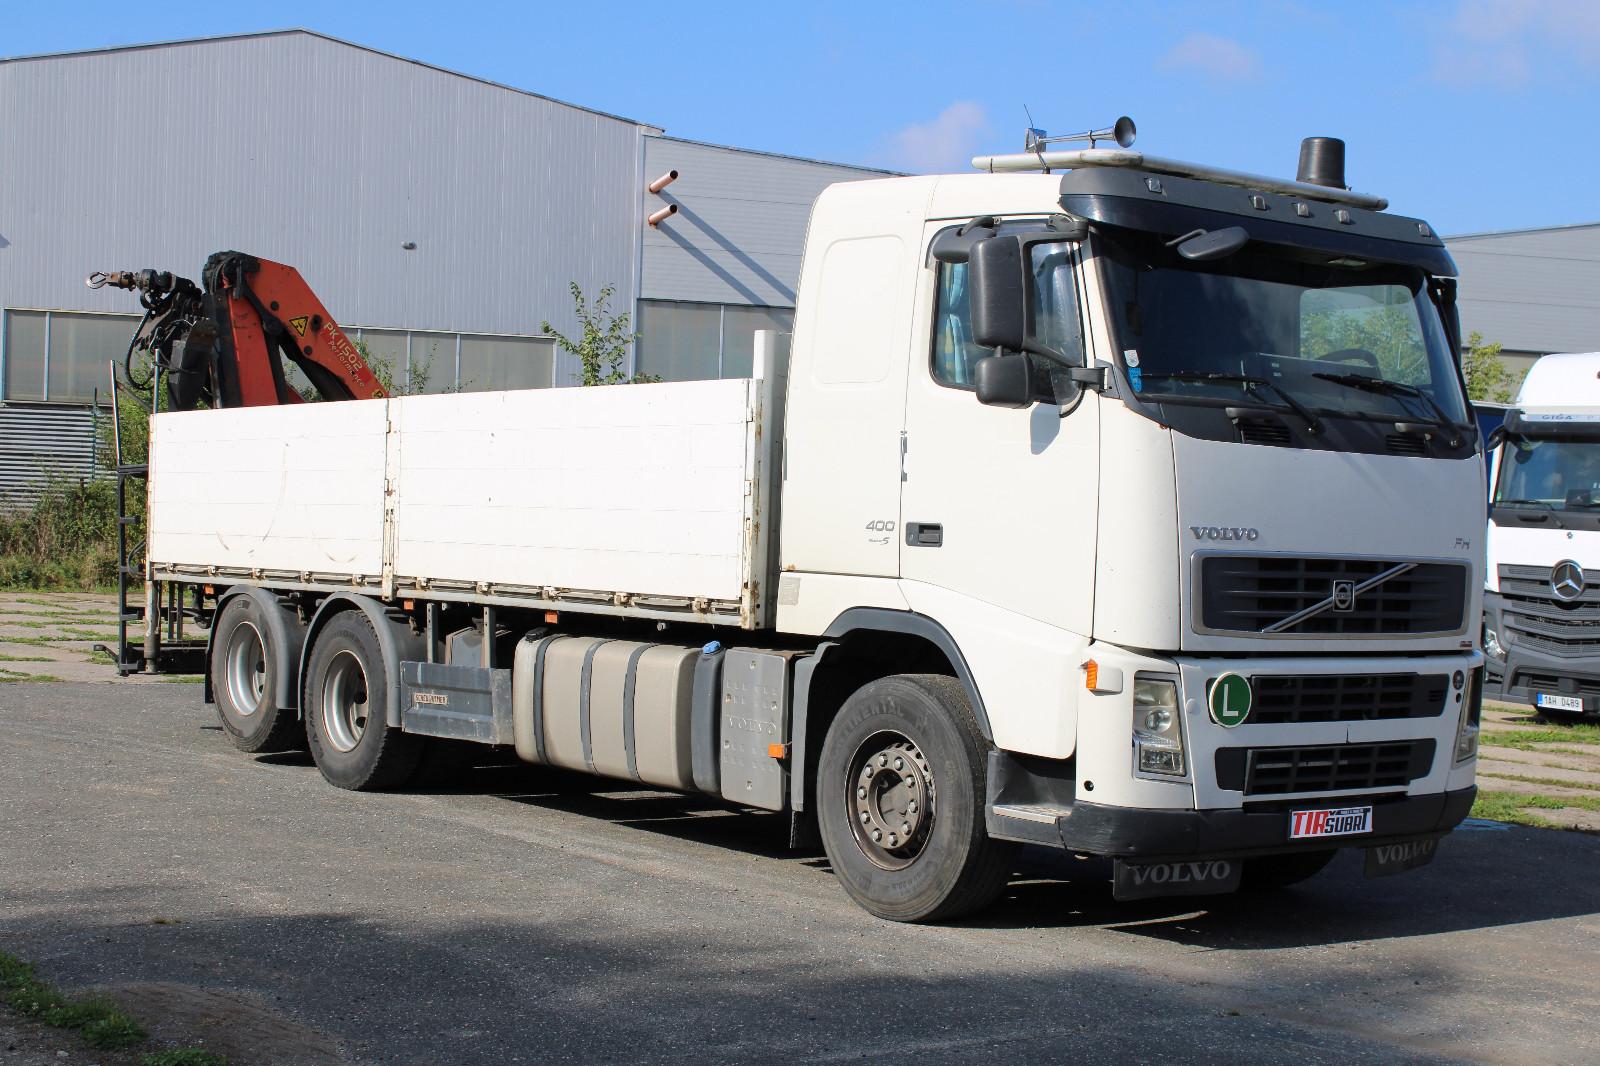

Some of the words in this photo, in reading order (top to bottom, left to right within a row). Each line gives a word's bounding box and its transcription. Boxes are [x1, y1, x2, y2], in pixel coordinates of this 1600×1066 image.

[324, 321, 340, 340] PK
[336, 338, 363, 372] 11502
[865, 519, 896, 532] 400
[1188, 525, 1260, 541] VOLVO
[1222, 683, 1239, 717] L
[1544, 696, 1557, 705] 1AH
[1293, 810, 1329, 836] TIR
[1376, 840, 1433, 865] VOLVO
[1127, 860, 1231, 885] VOLVO
